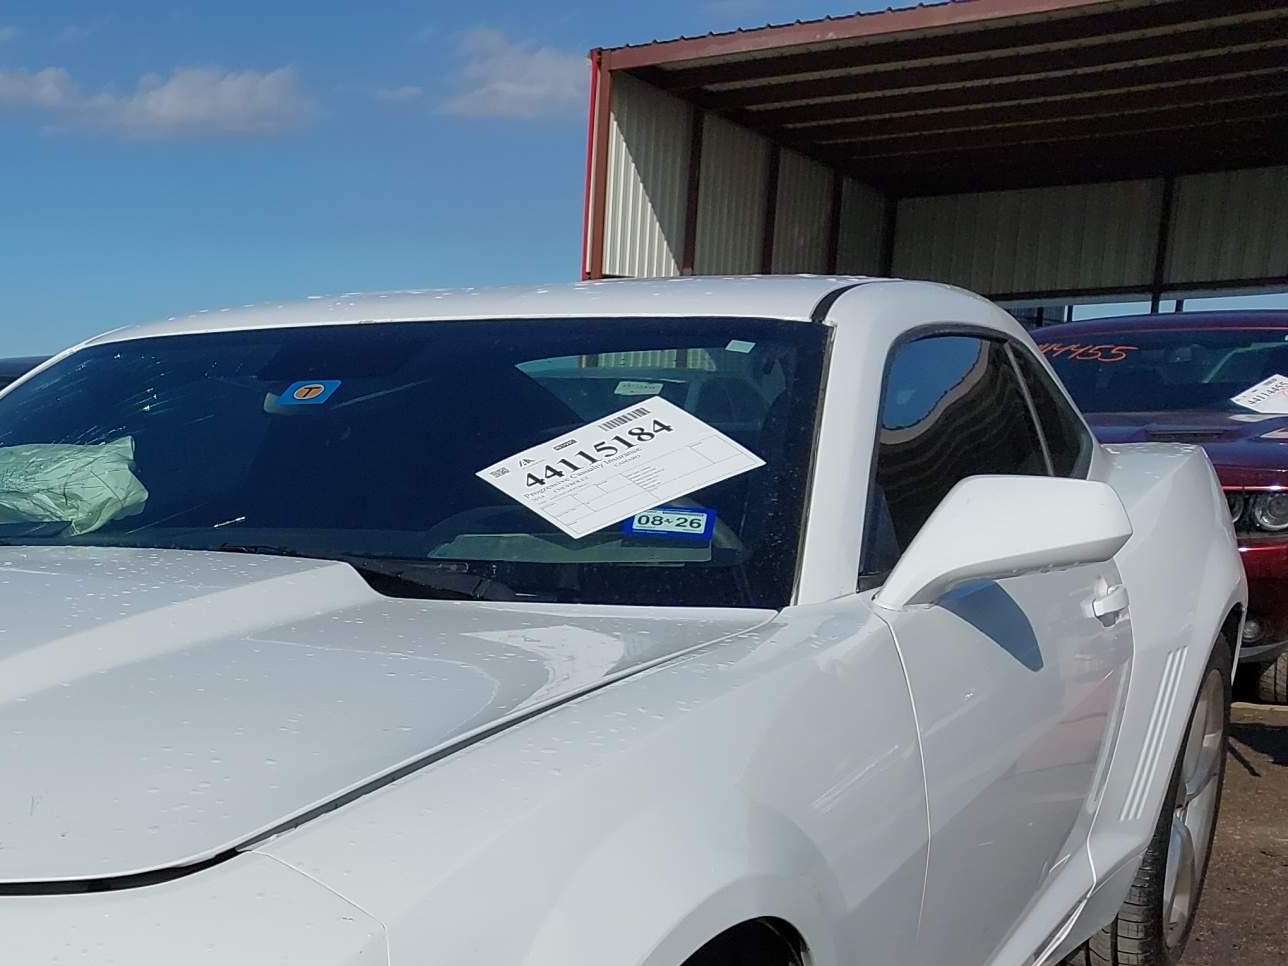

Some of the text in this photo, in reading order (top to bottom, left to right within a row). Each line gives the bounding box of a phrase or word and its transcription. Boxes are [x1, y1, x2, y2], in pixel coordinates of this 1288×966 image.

[525, 418, 674, 488] 44115184
[523, 477, 570, 498] Progressive
[570, 463, 604, 479] Casualty
[637, 514, 702, 529] 08 26
